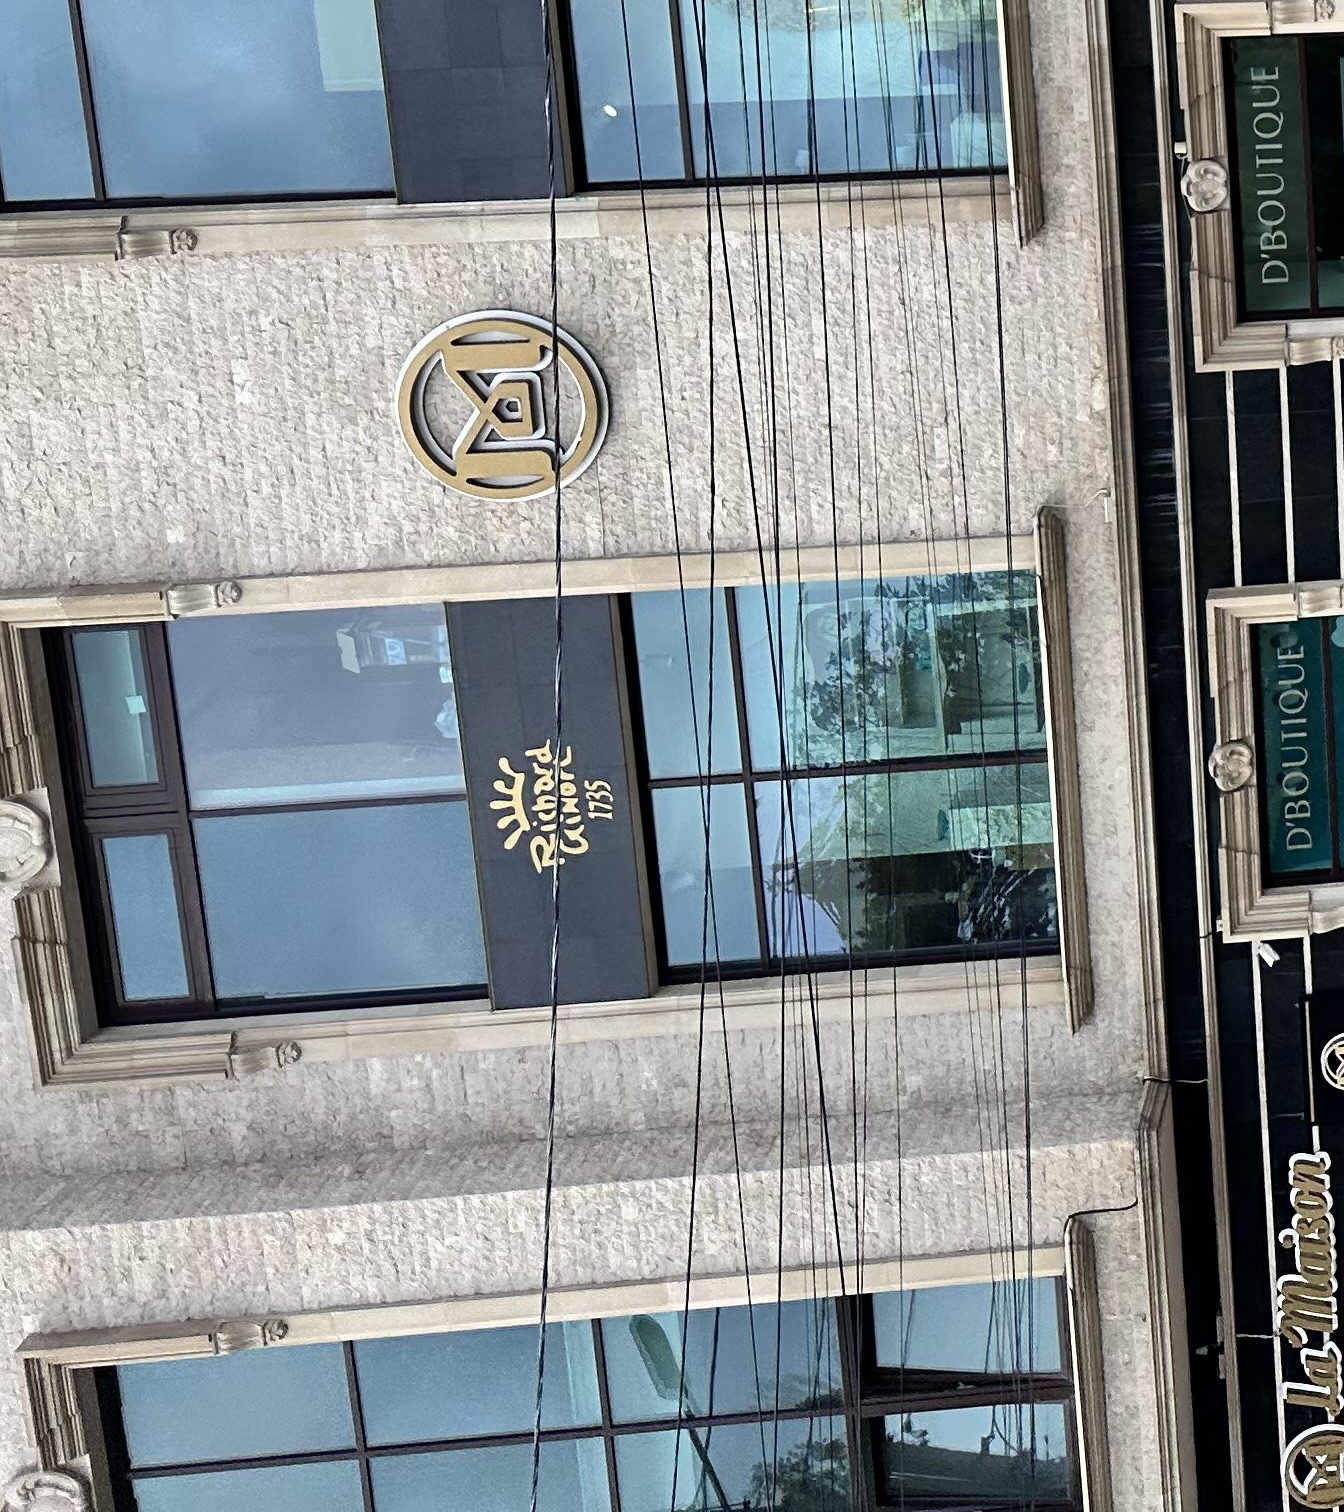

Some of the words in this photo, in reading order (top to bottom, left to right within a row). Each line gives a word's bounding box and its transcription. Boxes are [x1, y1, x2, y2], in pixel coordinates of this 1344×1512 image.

[1250, 66, 1290, 284] D'BOUTIQUE
[524, 739, 565, 873] Richard
[584, 780, 613, 820] 1735
[1276, 645, 1313, 850] D'BOUTIQUE
[1278, 1153, 1338, 1348] Maison
[1282, 1343, 1343, 1415] La
